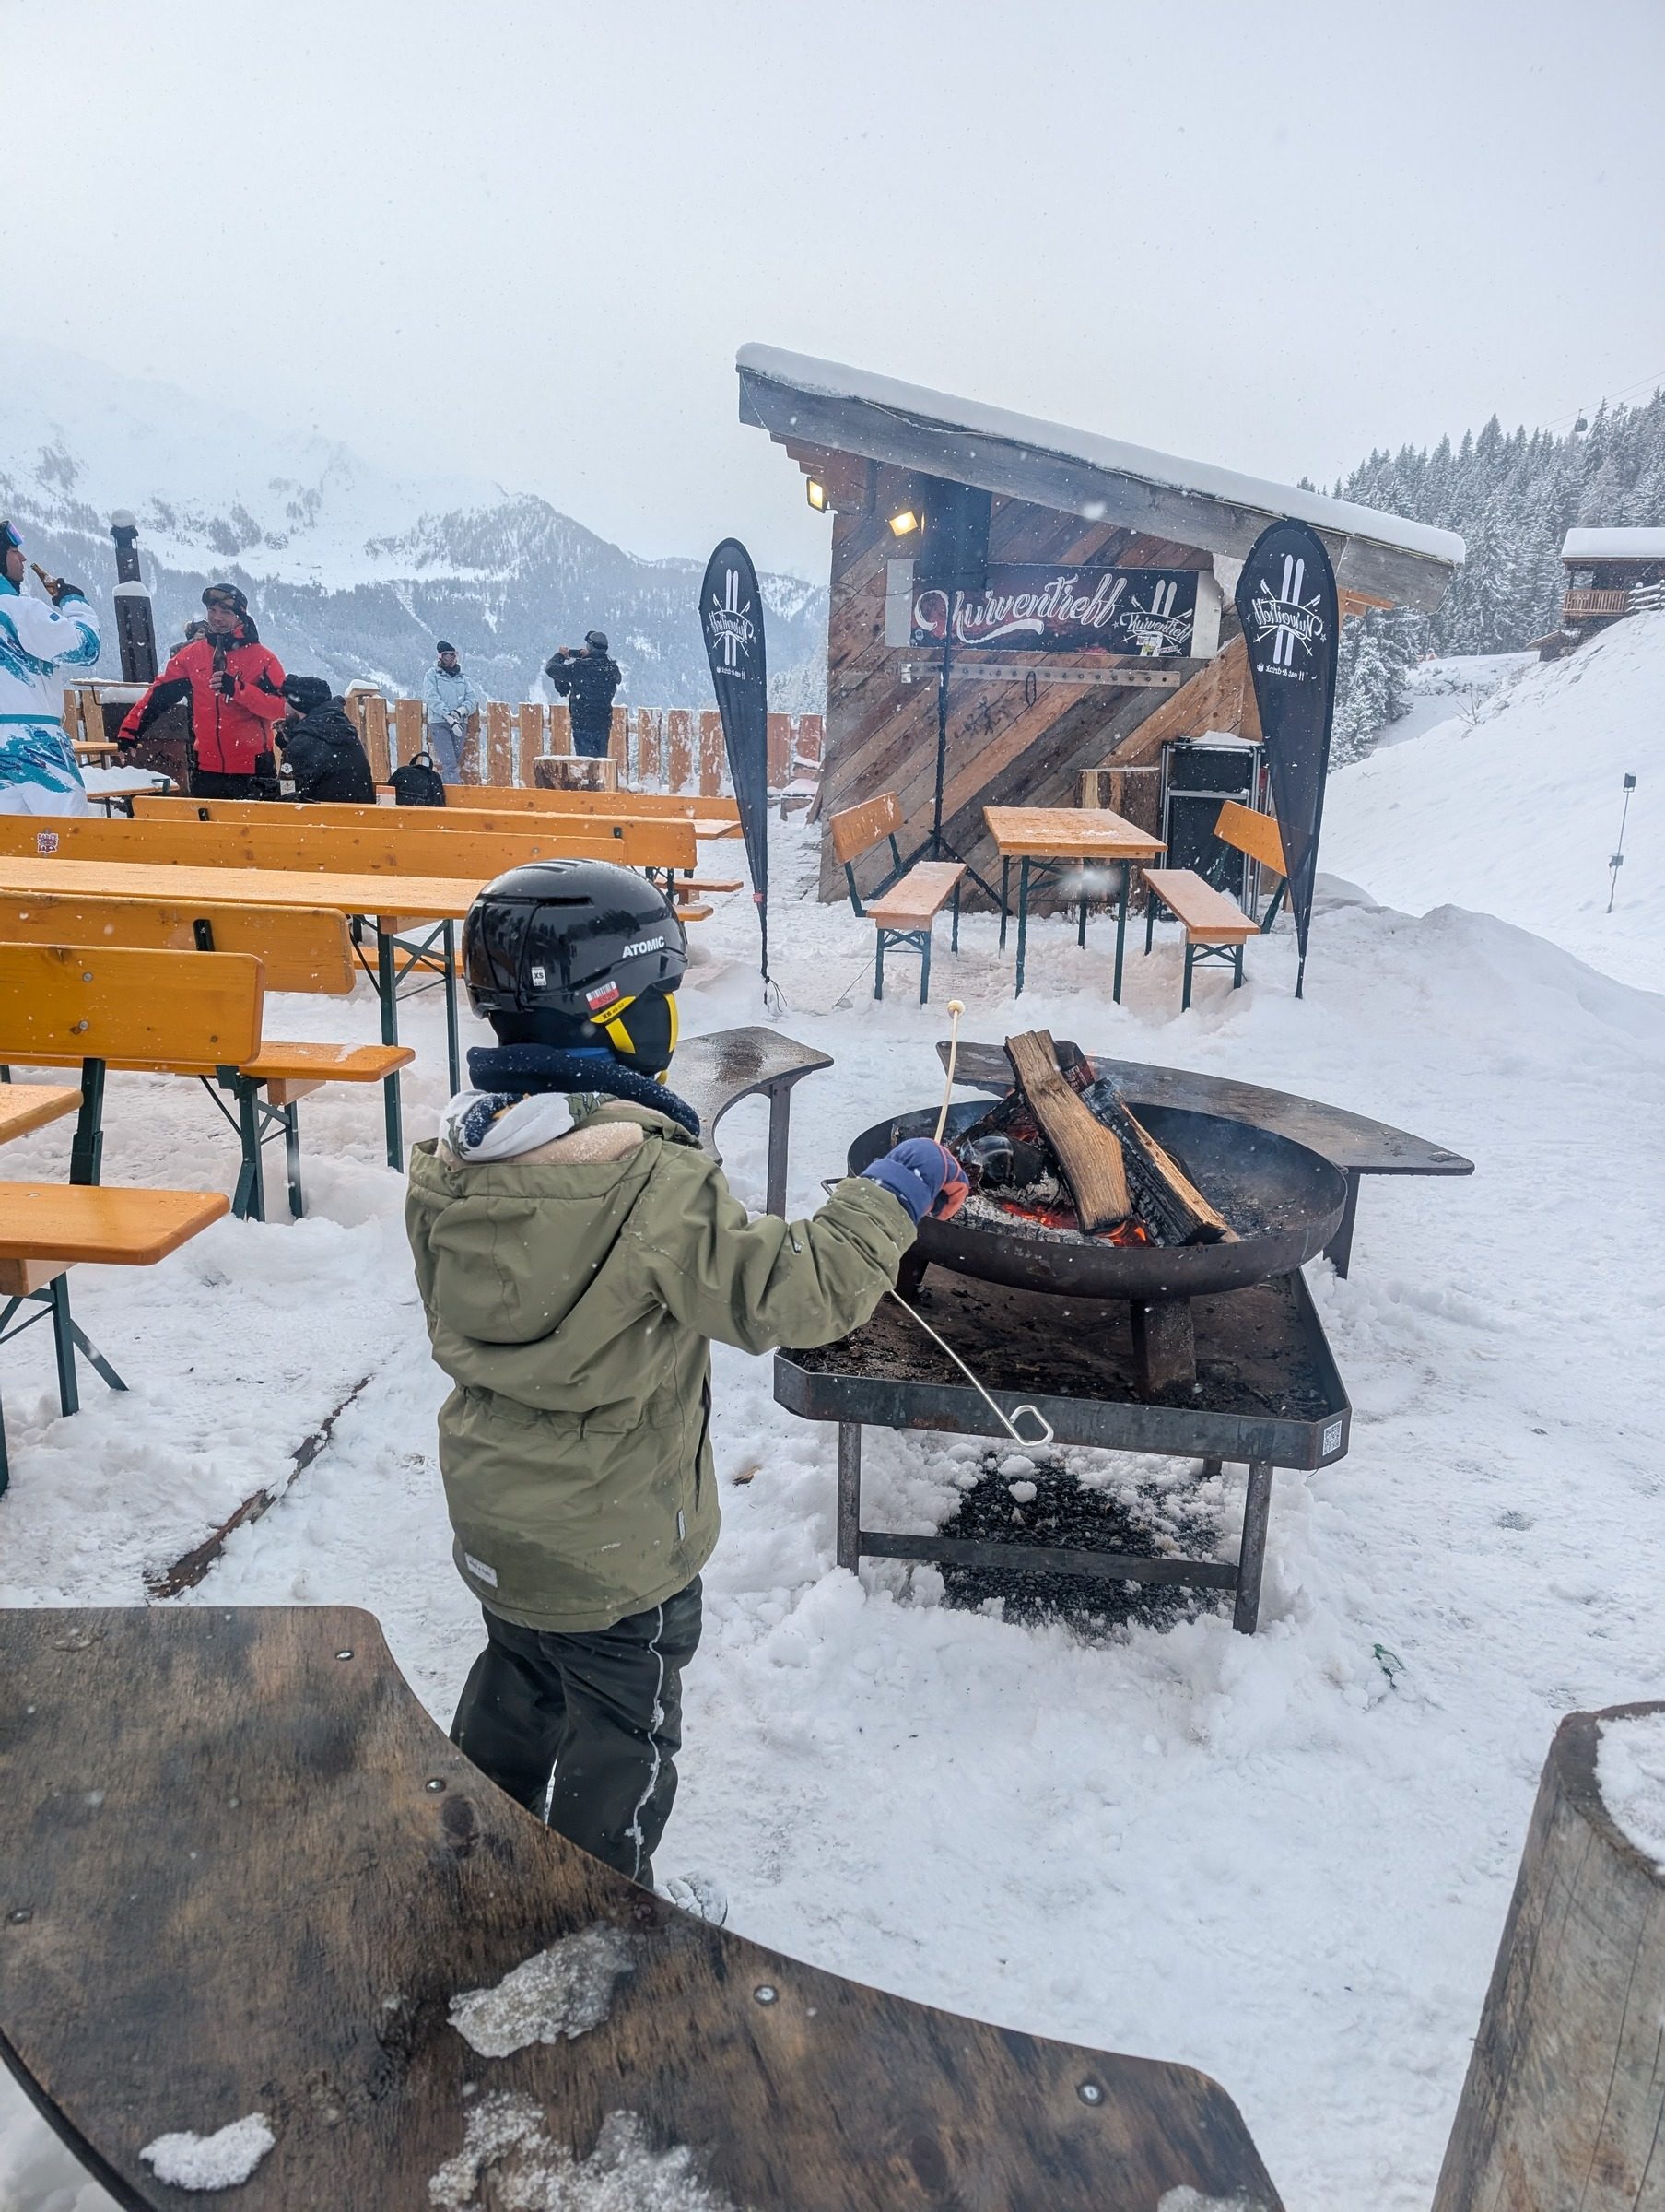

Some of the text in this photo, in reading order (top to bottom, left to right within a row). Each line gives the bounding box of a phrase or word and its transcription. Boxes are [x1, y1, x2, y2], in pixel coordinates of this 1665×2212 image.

[914, 573, 1127, 643] Kurventreff
[1120, 612, 1195, 643] Kurventreff
[622, 936, 665, 958] ATOMIC
